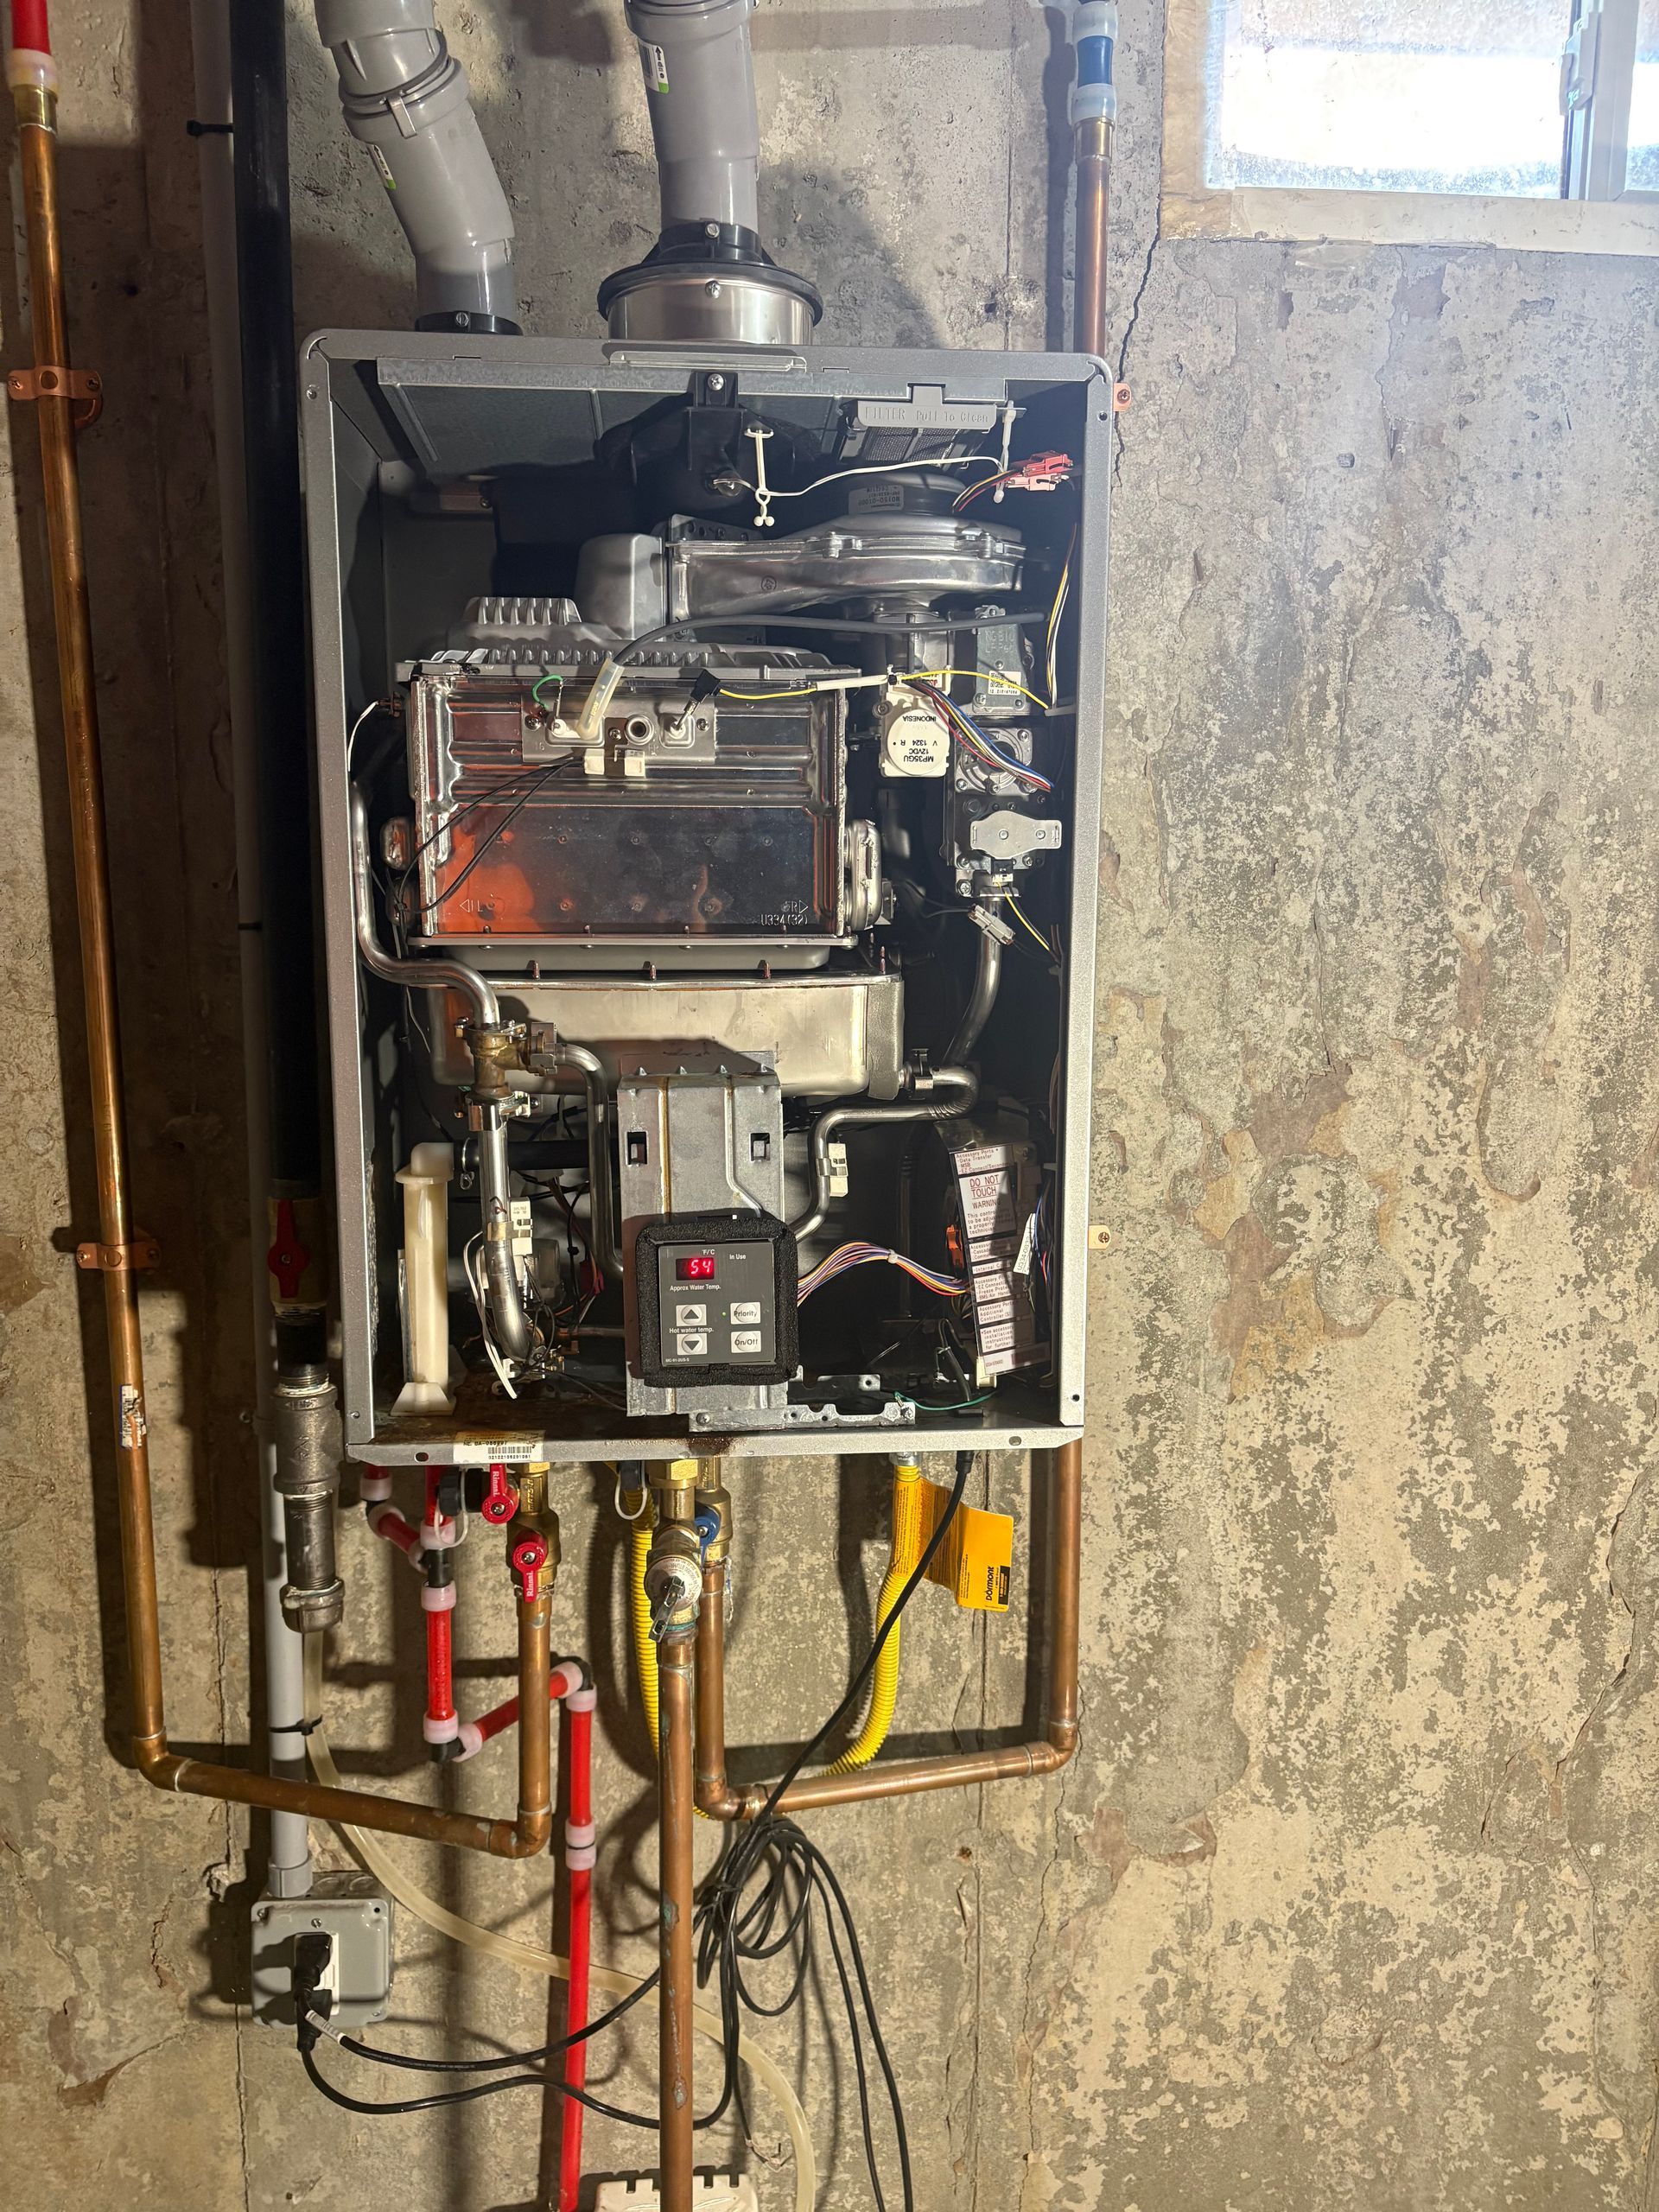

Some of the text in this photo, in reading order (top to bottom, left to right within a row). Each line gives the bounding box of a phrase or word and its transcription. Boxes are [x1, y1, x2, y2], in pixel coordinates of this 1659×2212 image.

[865, 407, 906, 421] FILTER
[960, 411, 989, 423] Clean
[969, 1175, 999, 1187] DO NOT
[971, 1186, 996, 1198] TOUCH
[690, 1259, 711, 1274] 54
